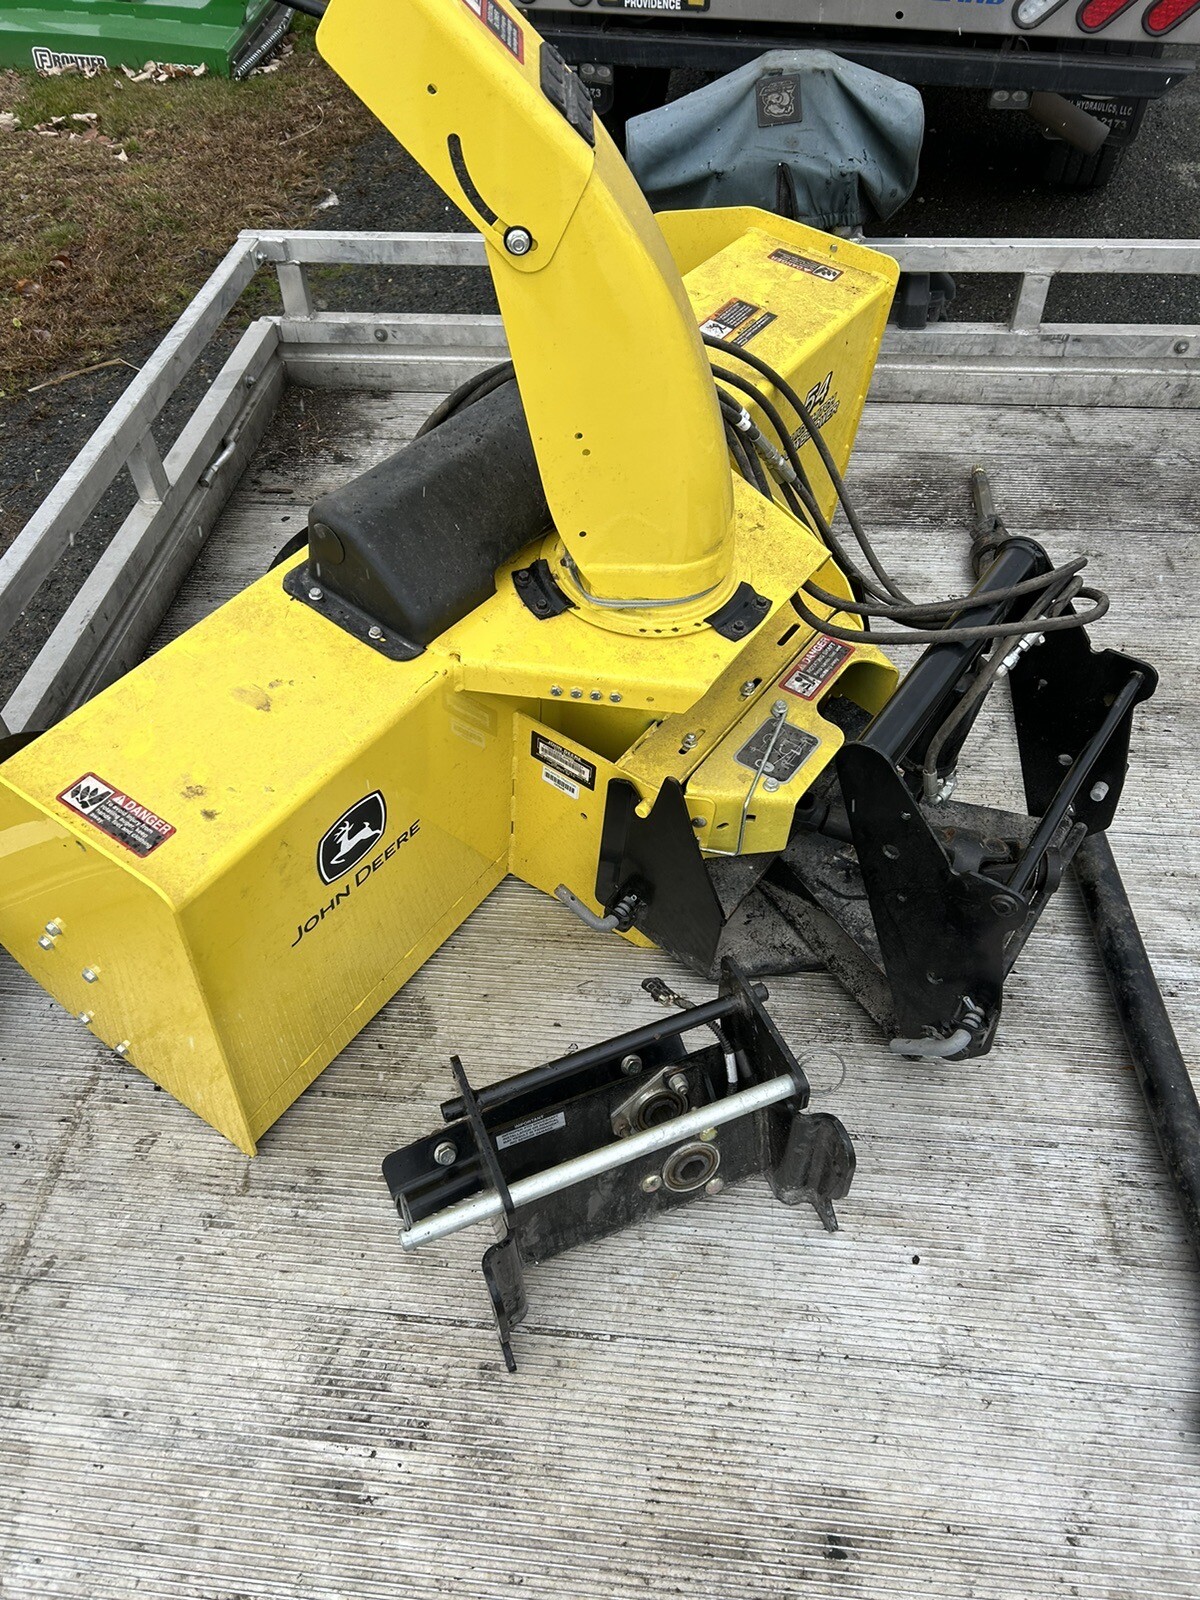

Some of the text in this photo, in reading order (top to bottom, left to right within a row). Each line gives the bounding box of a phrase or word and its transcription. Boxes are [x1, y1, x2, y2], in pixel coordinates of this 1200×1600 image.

[624, 0, 681, 9] PROVIDENCE
[33, 47, 105, 69] FRONTIER
[1076, 100, 1133, 116] HYDRAULICS, LLC
[803, 369, 833, 414] 54
[802, 637, 830, 664] DANGER
[98, 804, 121, 819] rotating
[133, 827, 148, 838] keep
[104, 799, 154, 834] To avoid injury from
[124, 801, 172, 835] DANGER
[110, 819, 123, 828] feet
[120, 826, 132, 835] and
[129, 832, 152, 849] clothing
[291, 819, 420, 947] JOHN DEERE
[513, 1114, 544, 1128] IMPORTANT
